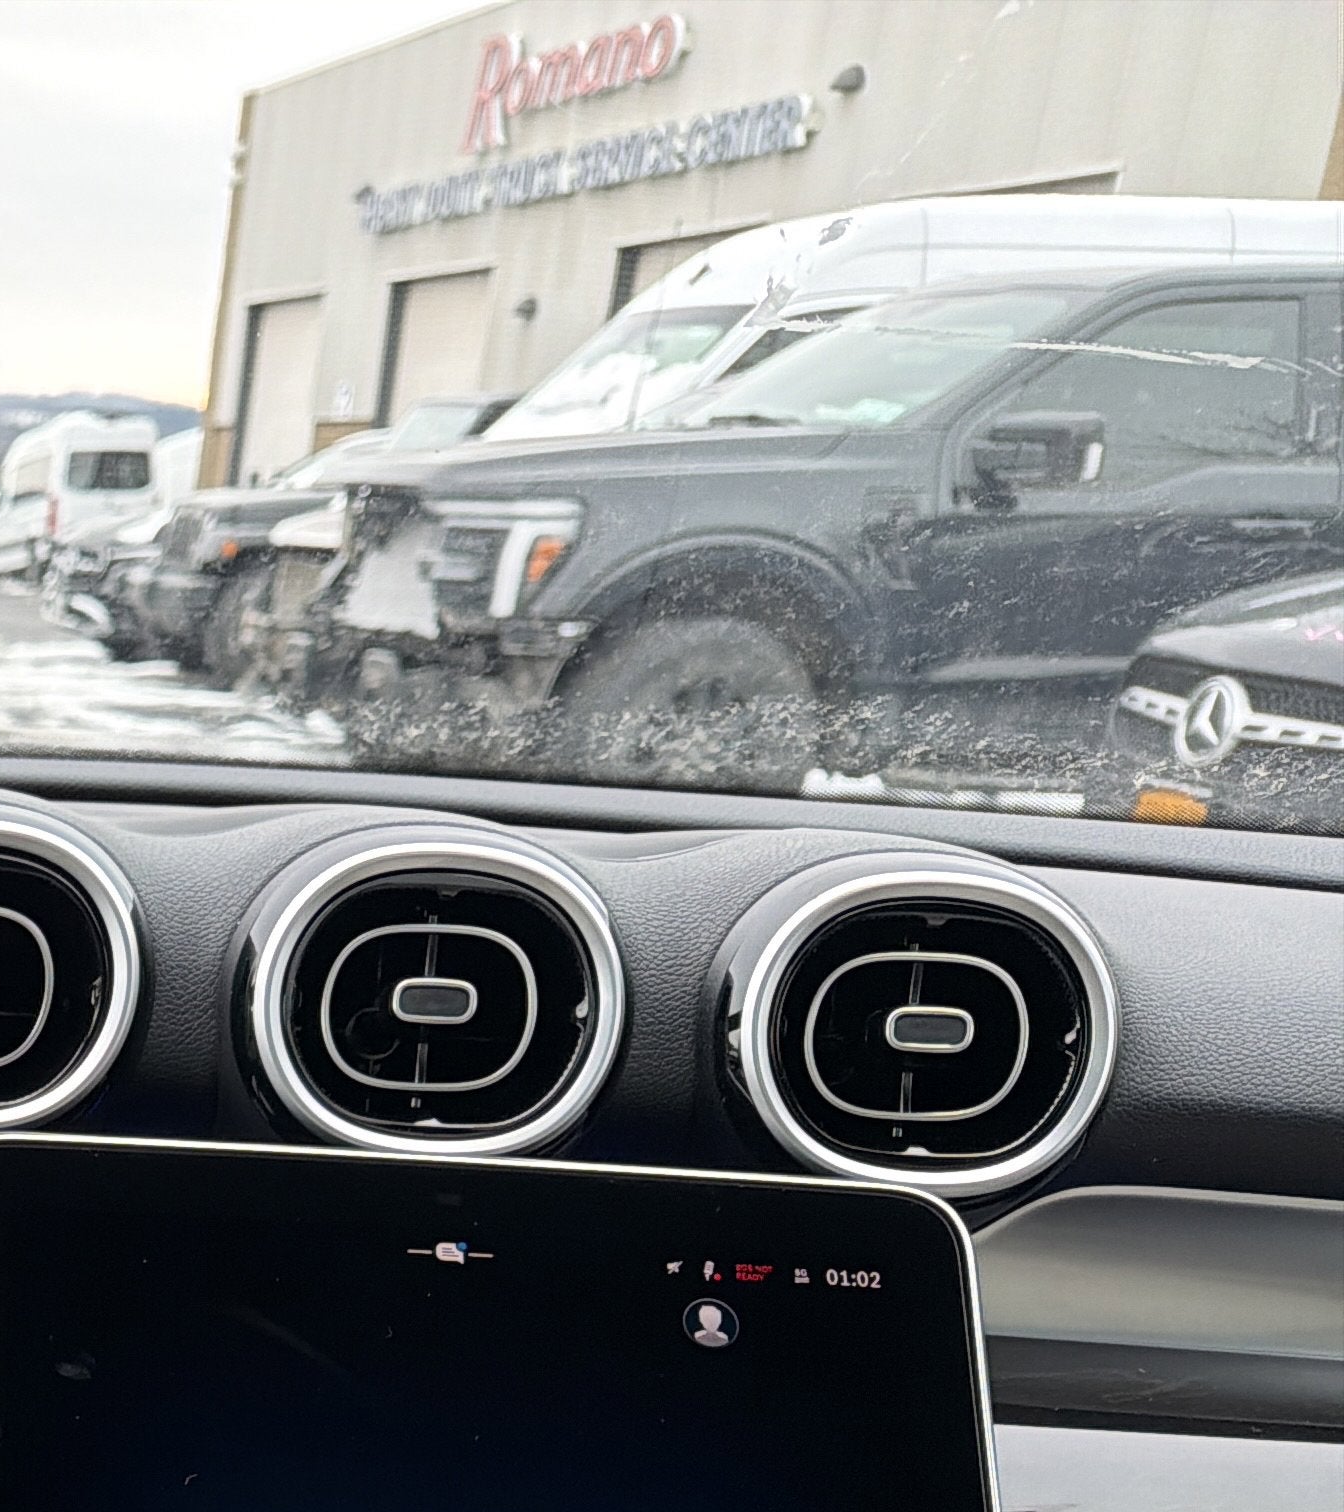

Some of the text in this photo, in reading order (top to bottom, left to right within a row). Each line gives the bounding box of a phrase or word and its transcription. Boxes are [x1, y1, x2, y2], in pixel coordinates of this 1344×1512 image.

[459, 14, 687, 153] Romano
[685, 95, 812, 170] CENTER
[825, 1268, 882, 1289] 01:02
